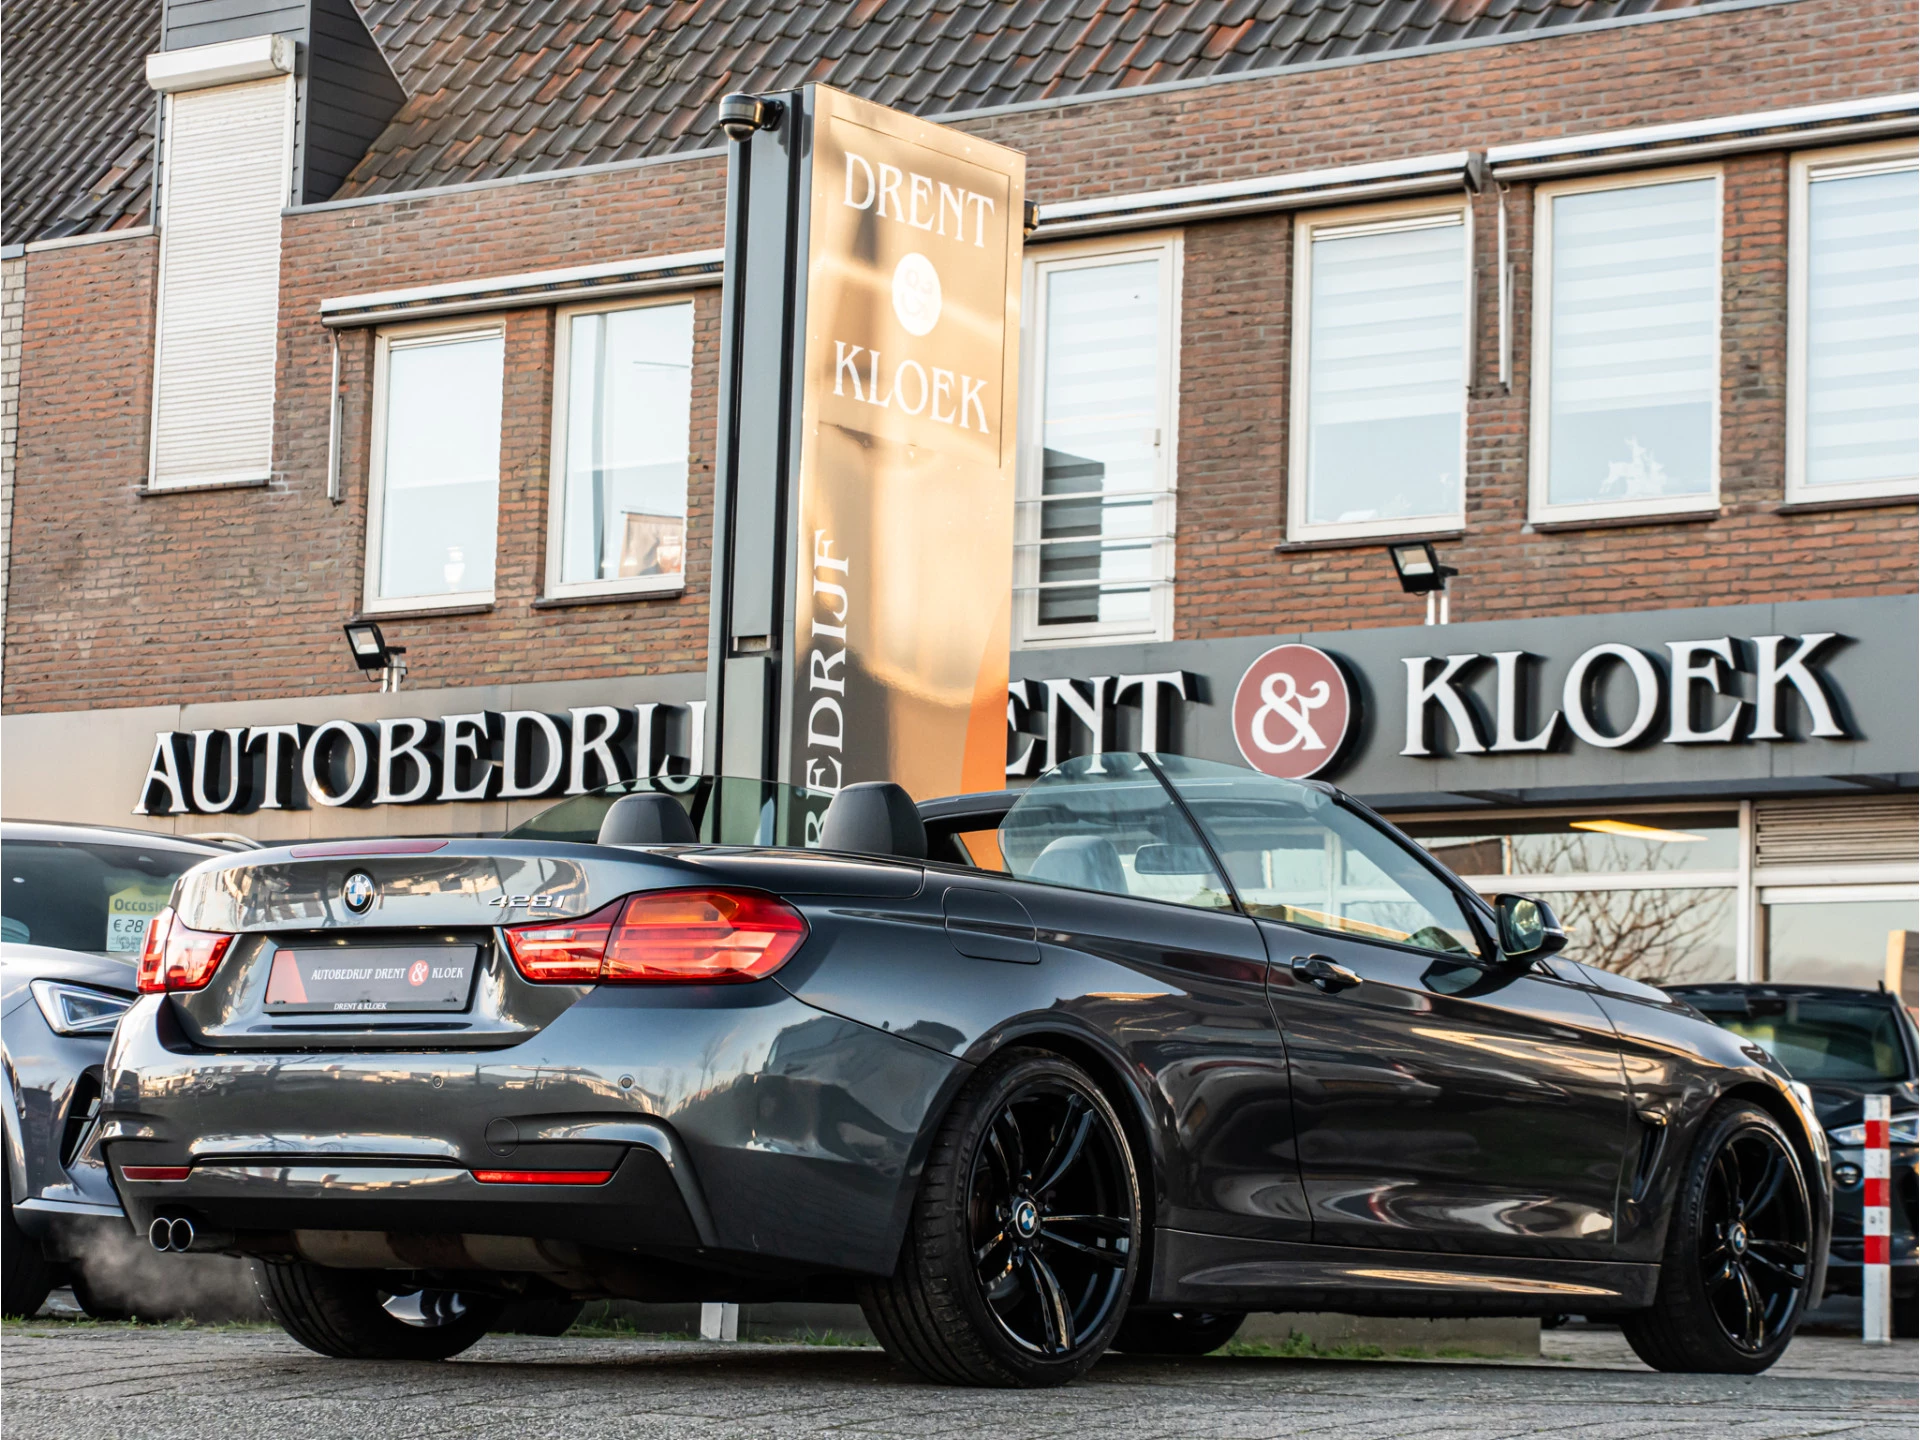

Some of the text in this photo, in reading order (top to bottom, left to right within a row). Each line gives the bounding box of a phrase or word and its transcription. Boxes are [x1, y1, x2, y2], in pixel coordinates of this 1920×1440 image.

[843, 151, 995, 249] DRENT
[832, 340, 990, 434] KLOEK
[1251, 672, 1330, 754] &
[1399, 632, 1845, 755] KLOEK
[311, 962, 464, 982] AUTOBEDRIJF DRENT & KLOEK
[334, 1002, 387, 1010] DRENT & KLOEK
